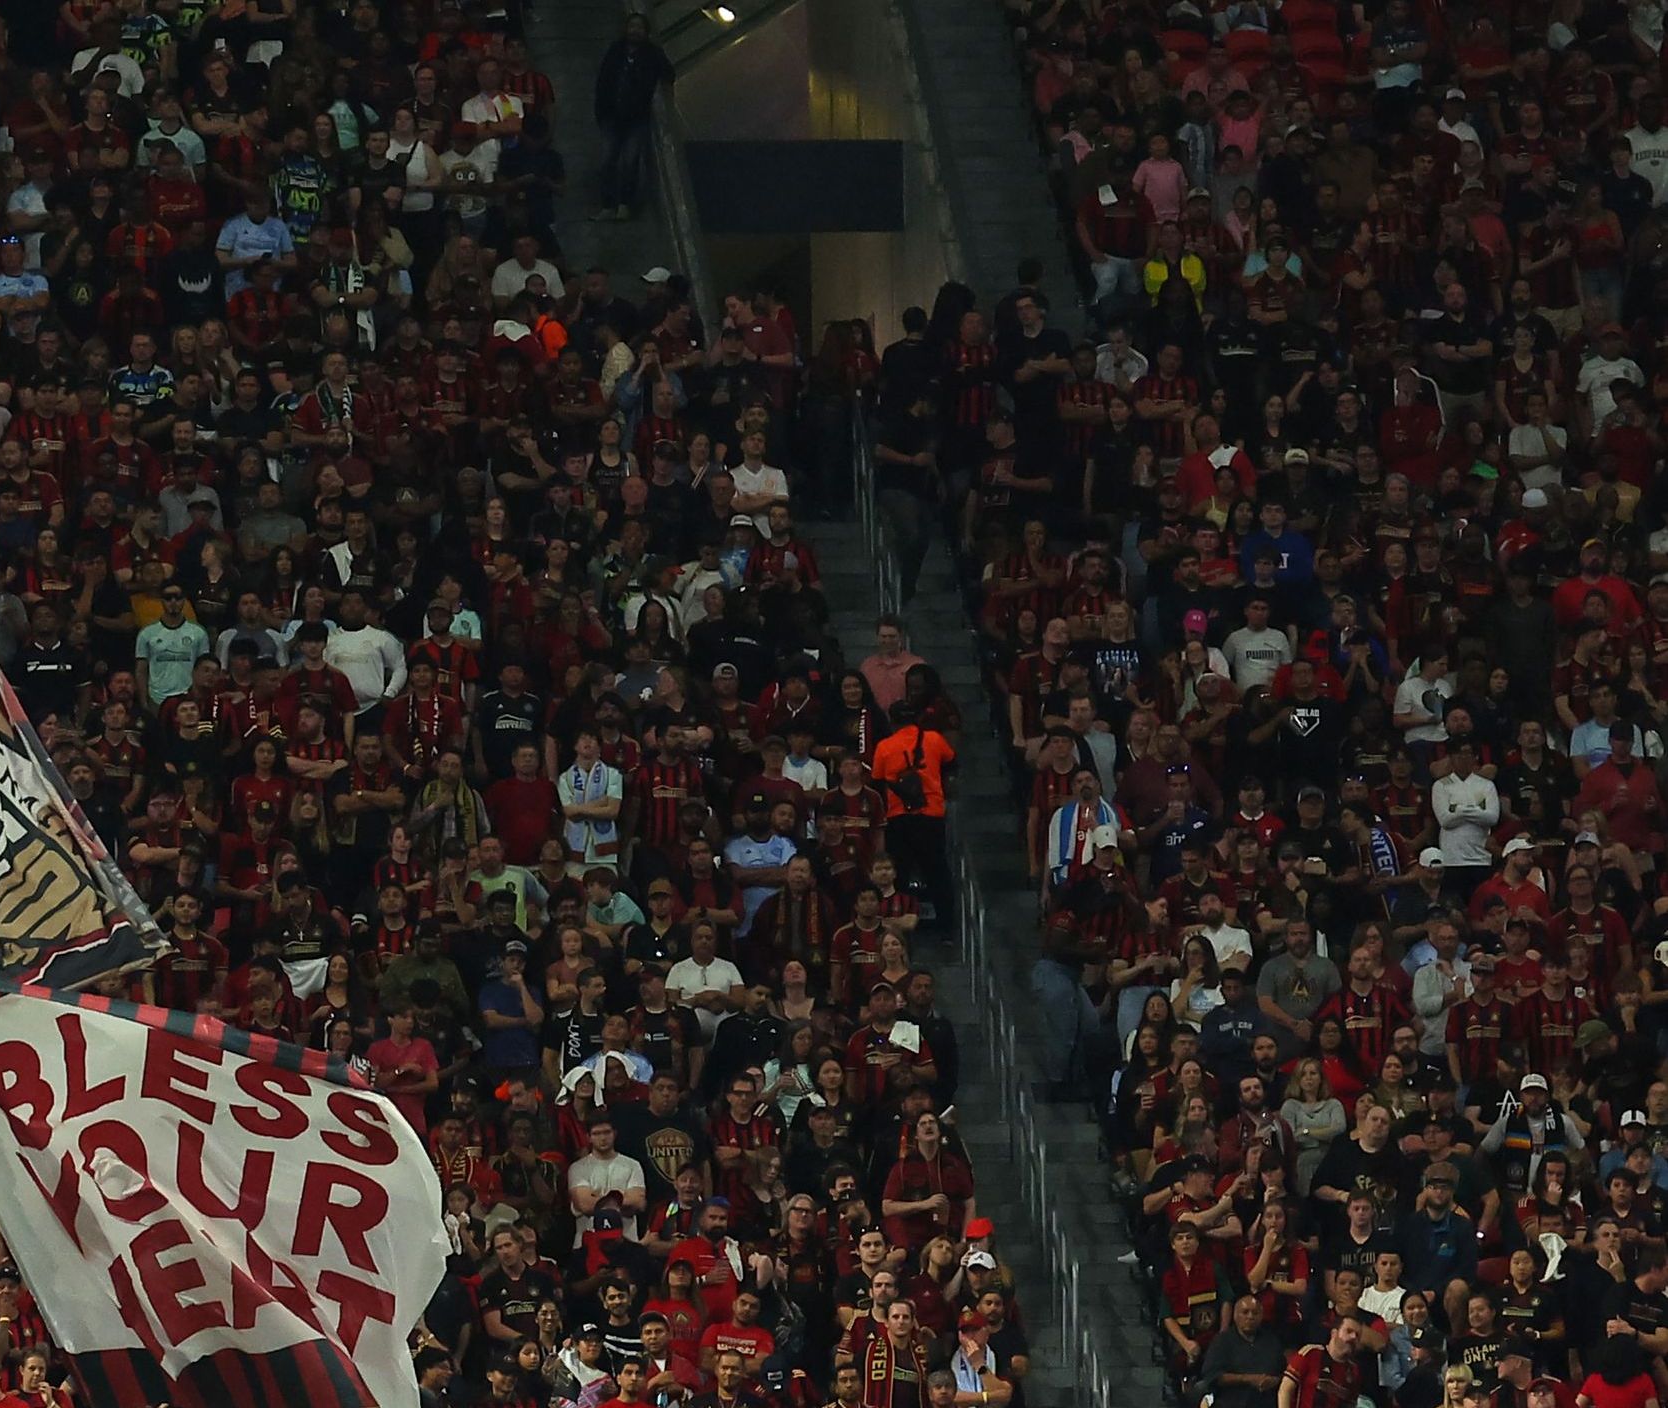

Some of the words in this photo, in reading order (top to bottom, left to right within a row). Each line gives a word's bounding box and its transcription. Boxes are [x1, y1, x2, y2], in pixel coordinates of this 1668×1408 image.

[16, 1119, 389, 1273] YOUR
[648, 1146, 692, 1158] UNITED
[109, 1219, 396, 1361] EAT
